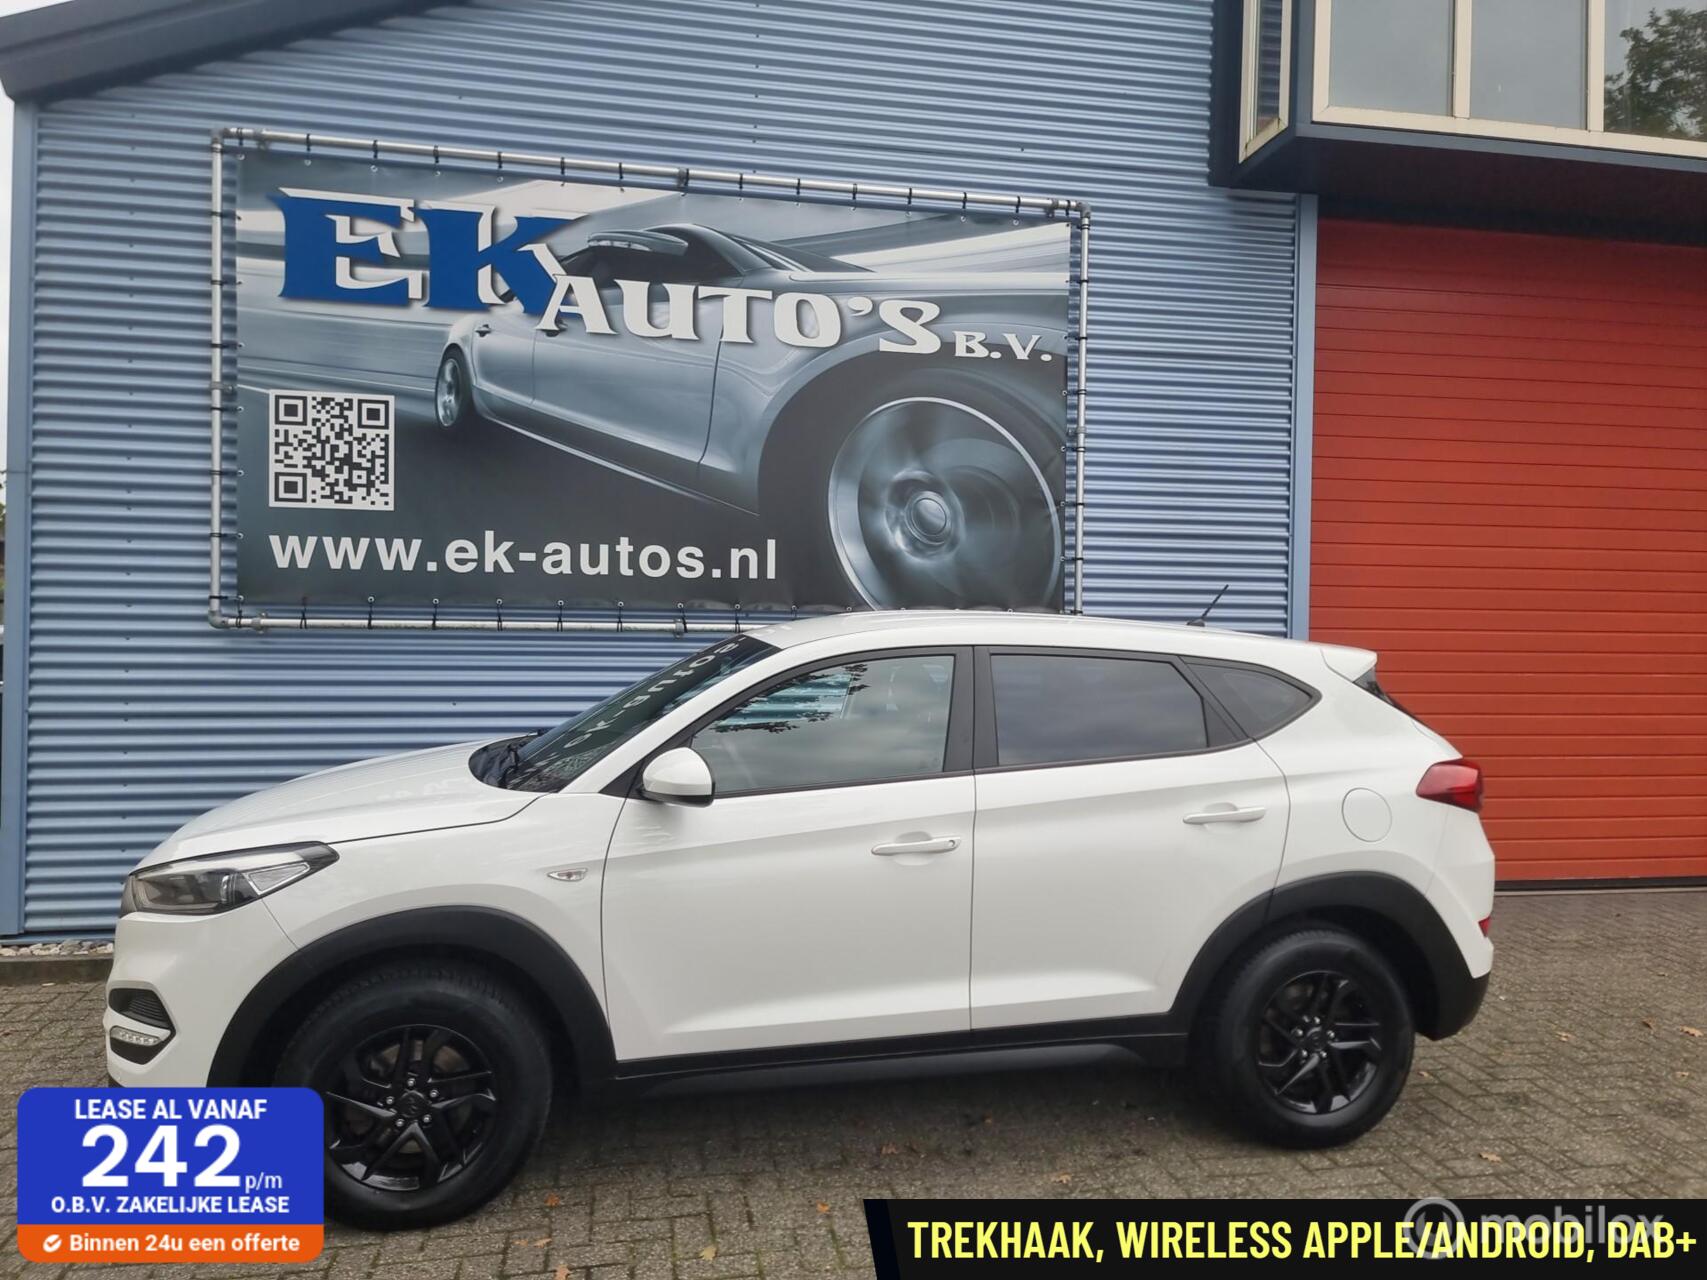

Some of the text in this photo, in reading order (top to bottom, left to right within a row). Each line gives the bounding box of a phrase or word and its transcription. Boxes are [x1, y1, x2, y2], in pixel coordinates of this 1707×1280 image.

[266, 187, 591, 319] EK
[953, 330, 1053, 362] B.V.
[268, 531, 778, 581] www.ek-autos.nl
